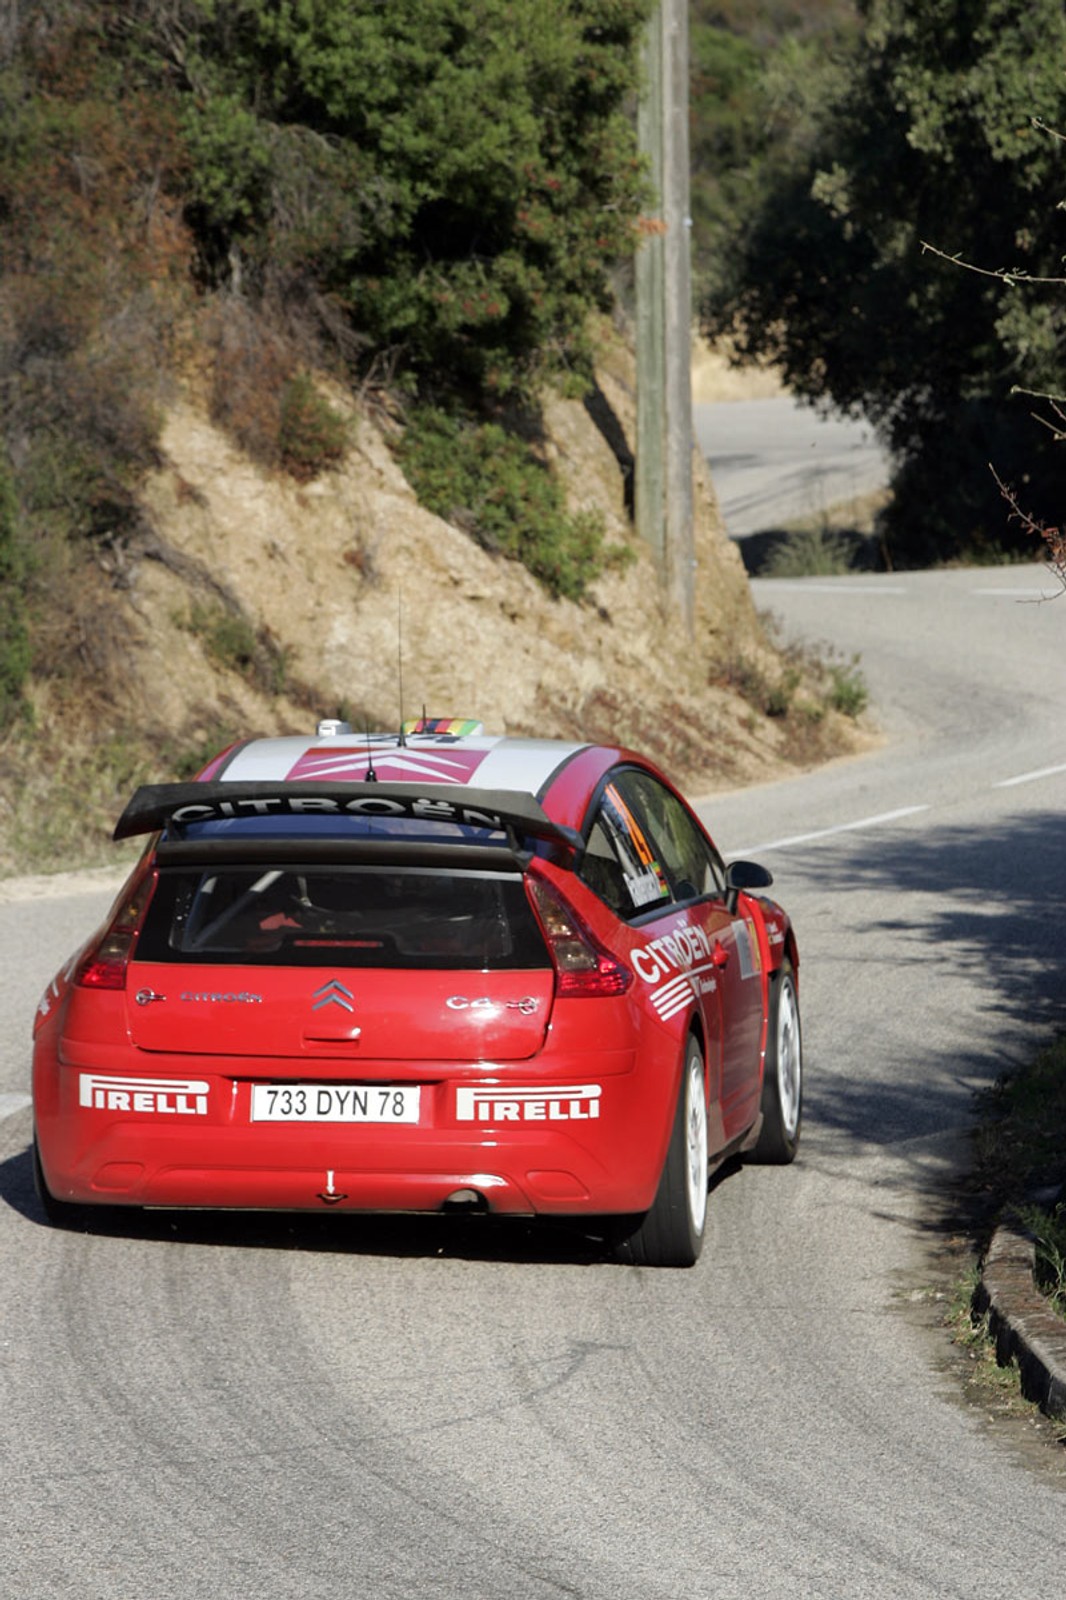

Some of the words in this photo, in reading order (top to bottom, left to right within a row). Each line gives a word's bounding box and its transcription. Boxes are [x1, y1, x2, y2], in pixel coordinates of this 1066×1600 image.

[171, 797, 501, 828] CITROËN
[630, 918, 711, 984] CITROËN
[446, 996, 495, 1010] C4
[79, 1073, 210, 1115] PIRELLI
[267, 1090, 307, 1116] 733
[317, 1090, 368, 1116] DYN
[378, 1091, 405, 1117] 78
[456, 1084, 602, 1121] PIRELLI
